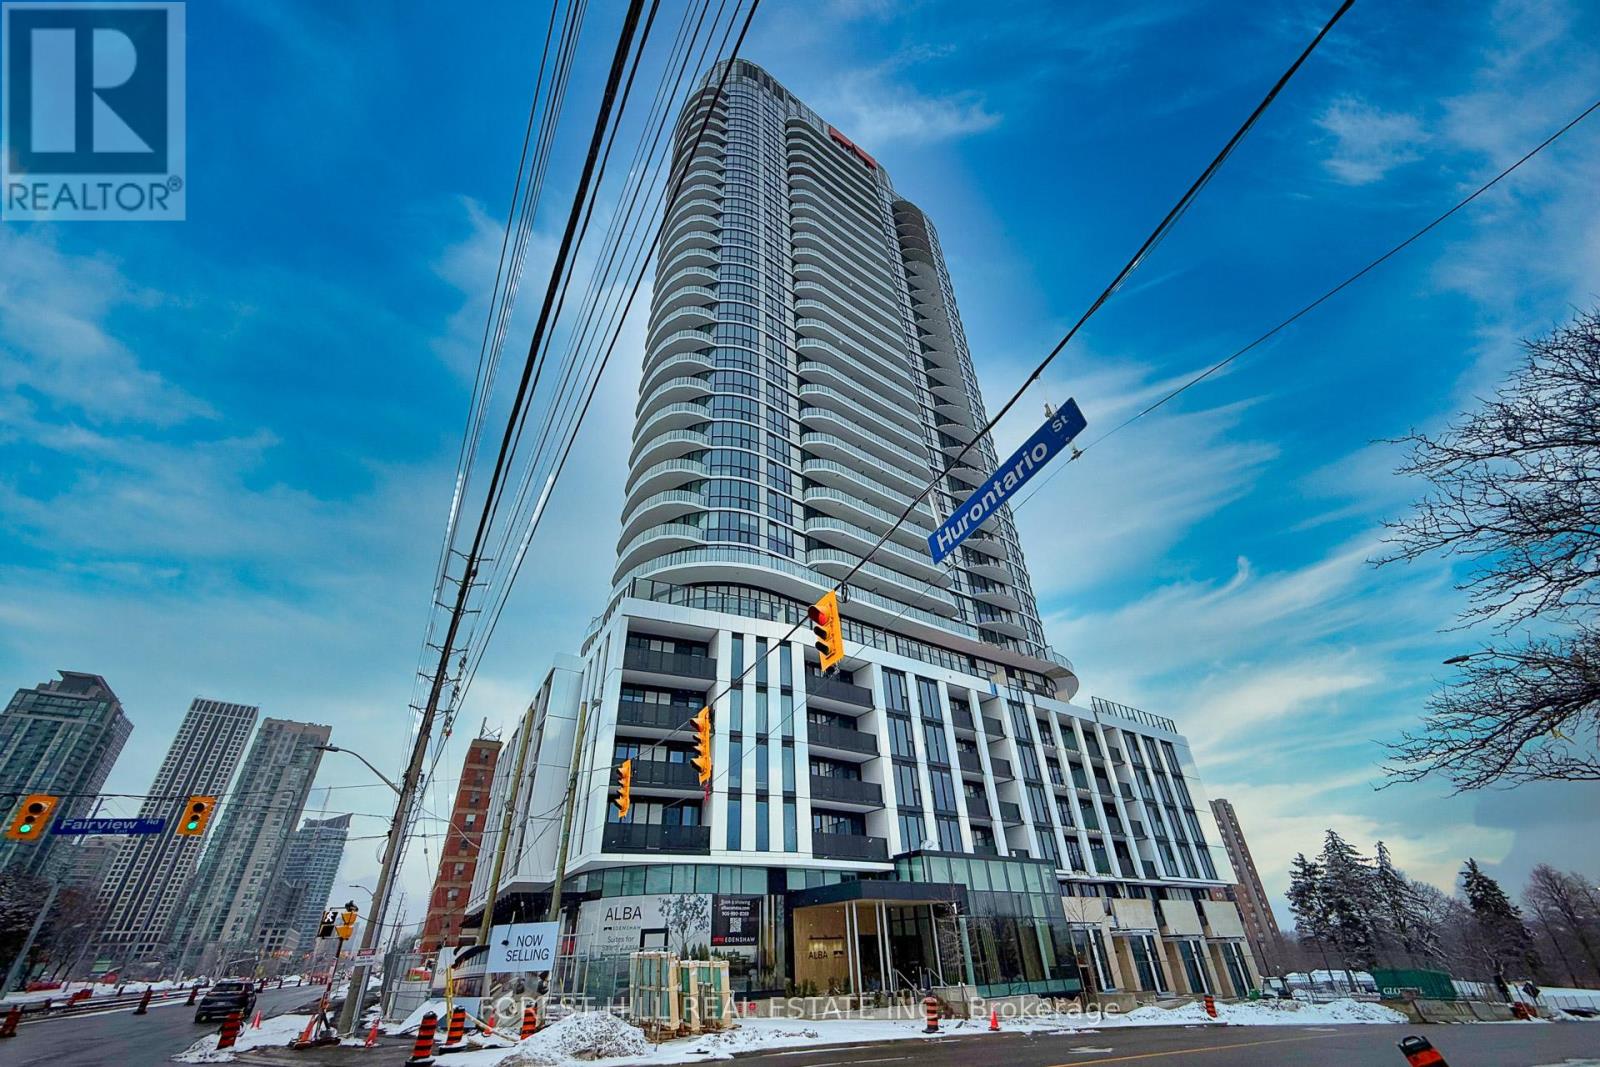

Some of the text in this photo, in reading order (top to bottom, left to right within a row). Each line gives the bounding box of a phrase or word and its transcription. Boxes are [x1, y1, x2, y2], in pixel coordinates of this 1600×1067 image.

[936, 415, 1070, 552] Hurontario St
[60, 818, 138, 830] Fairview
[605, 906, 642, 921] ALBA
[516, 934, 543, 947] NOW
[505, 948, 550, 962] SELLING
[808, 950, 828, 960] ALBA
